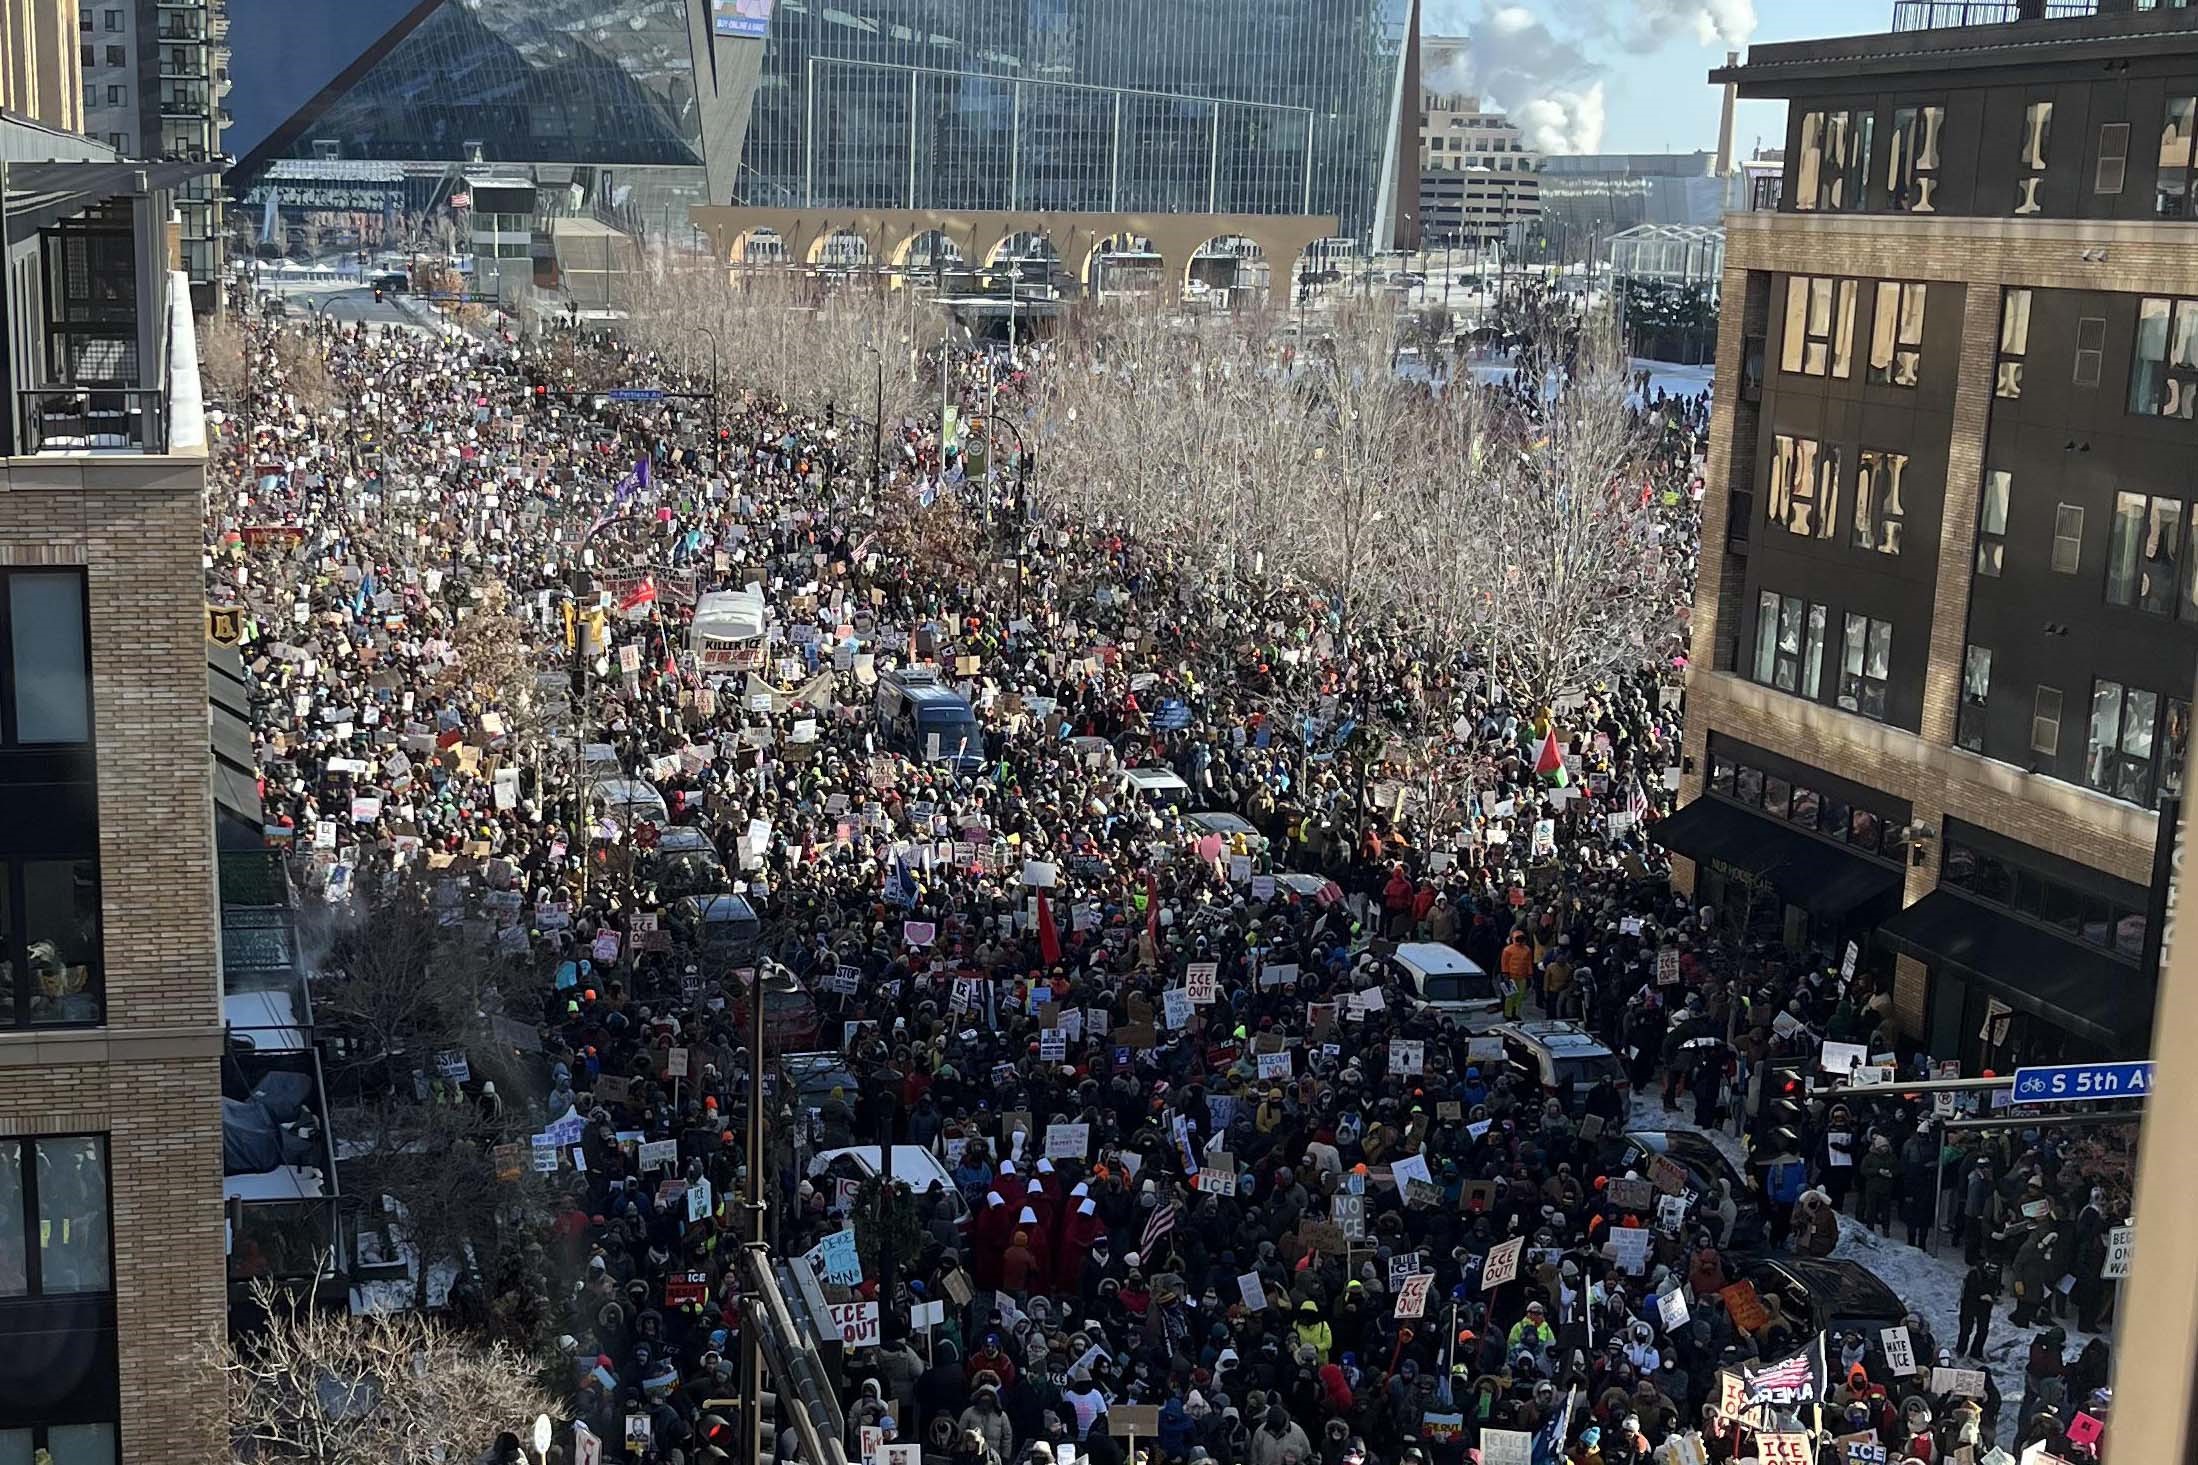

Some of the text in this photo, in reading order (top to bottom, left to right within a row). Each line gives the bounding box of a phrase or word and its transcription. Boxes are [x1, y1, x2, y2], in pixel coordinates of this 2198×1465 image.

[717, 19, 729, 28] BUY
[729, 20, 748, 30] ONLINE
[619, 565, 680, 577] MINNESOTA
[705, 638, 761, 651] KILLER ICE
[632, 921, 653, 932] ICE
[1659, 957, 1676, 969] ICE
[836, 966, 860, 980] STOP
[1190, 973, 1212, 985] ICE
[1188, 986, 1213, 997] OUT!
[1220, 1039, 1234, 1049] ICE
[1259, 1056, 1275, 1065] ICE
[2051, 1073, 2067, 1093] S
[2076, 1069, 2117, 1092] 5th
[1203, 1177, 1233, 1195] ICE
[1334, 1197, 1361, 1217] NO
[1489, 1250, 1513, 1266] ICE
[1390, 1262, 1419, 1274] ICE
[1485, 1263, 1513, 1281] OUT!
[688, 1273, 706, 1283] ICE
[831, 1271, 854, 1285] MN
[1403, 1278, 1428, 1298] ICE
[829, 1303, 867, 1326] ICE
[843, 1317, 879, 1343] OUT
[1890, 1329, 1897, 1339] I
[1885, 1340, 1907, 1354] HATE
[1892, 1353, 1910, 1368] ICE
[1763, 1442, 1801, 1458] ICE
[1848, 1443, 1885, 1462] ICE
